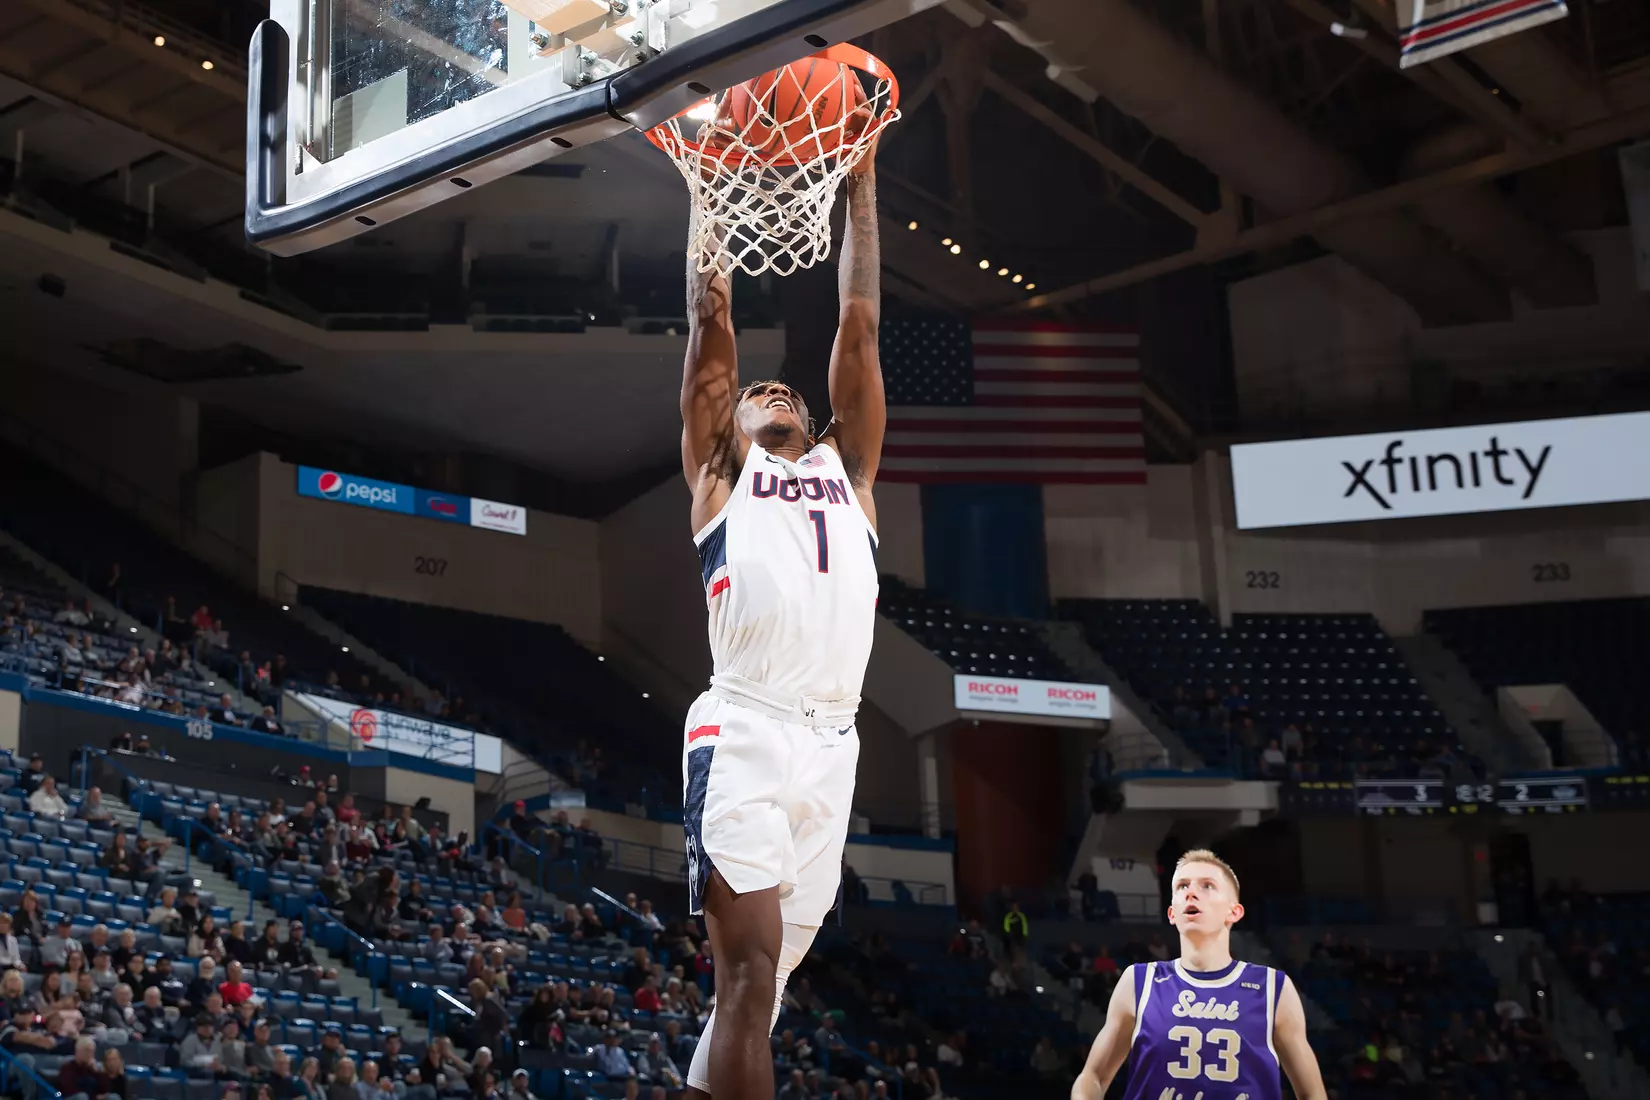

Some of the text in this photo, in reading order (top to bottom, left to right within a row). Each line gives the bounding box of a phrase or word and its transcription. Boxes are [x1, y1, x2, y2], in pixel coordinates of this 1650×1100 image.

[1341, 436, 1552, 510] xfinity
[346, 482, 397, 504] pepsi
[809, 510, 828, 573] 1
[415, 557, 447, 577] 207
[1532, 563, 1571, 582] 233
[1246, 572, 1281, 588] 232
[968, 682, 1018, 696] RICOH
[1047, 687, 1096, 701] RICOH
[186, 721, 213, 740] 105
[1414, 785, 1428, 801] 3
[1515, 784, 1529, 801] 2
[1172, 989, 1240, 1022] Saint
[1167, 1025, 1241, 1082] 33
